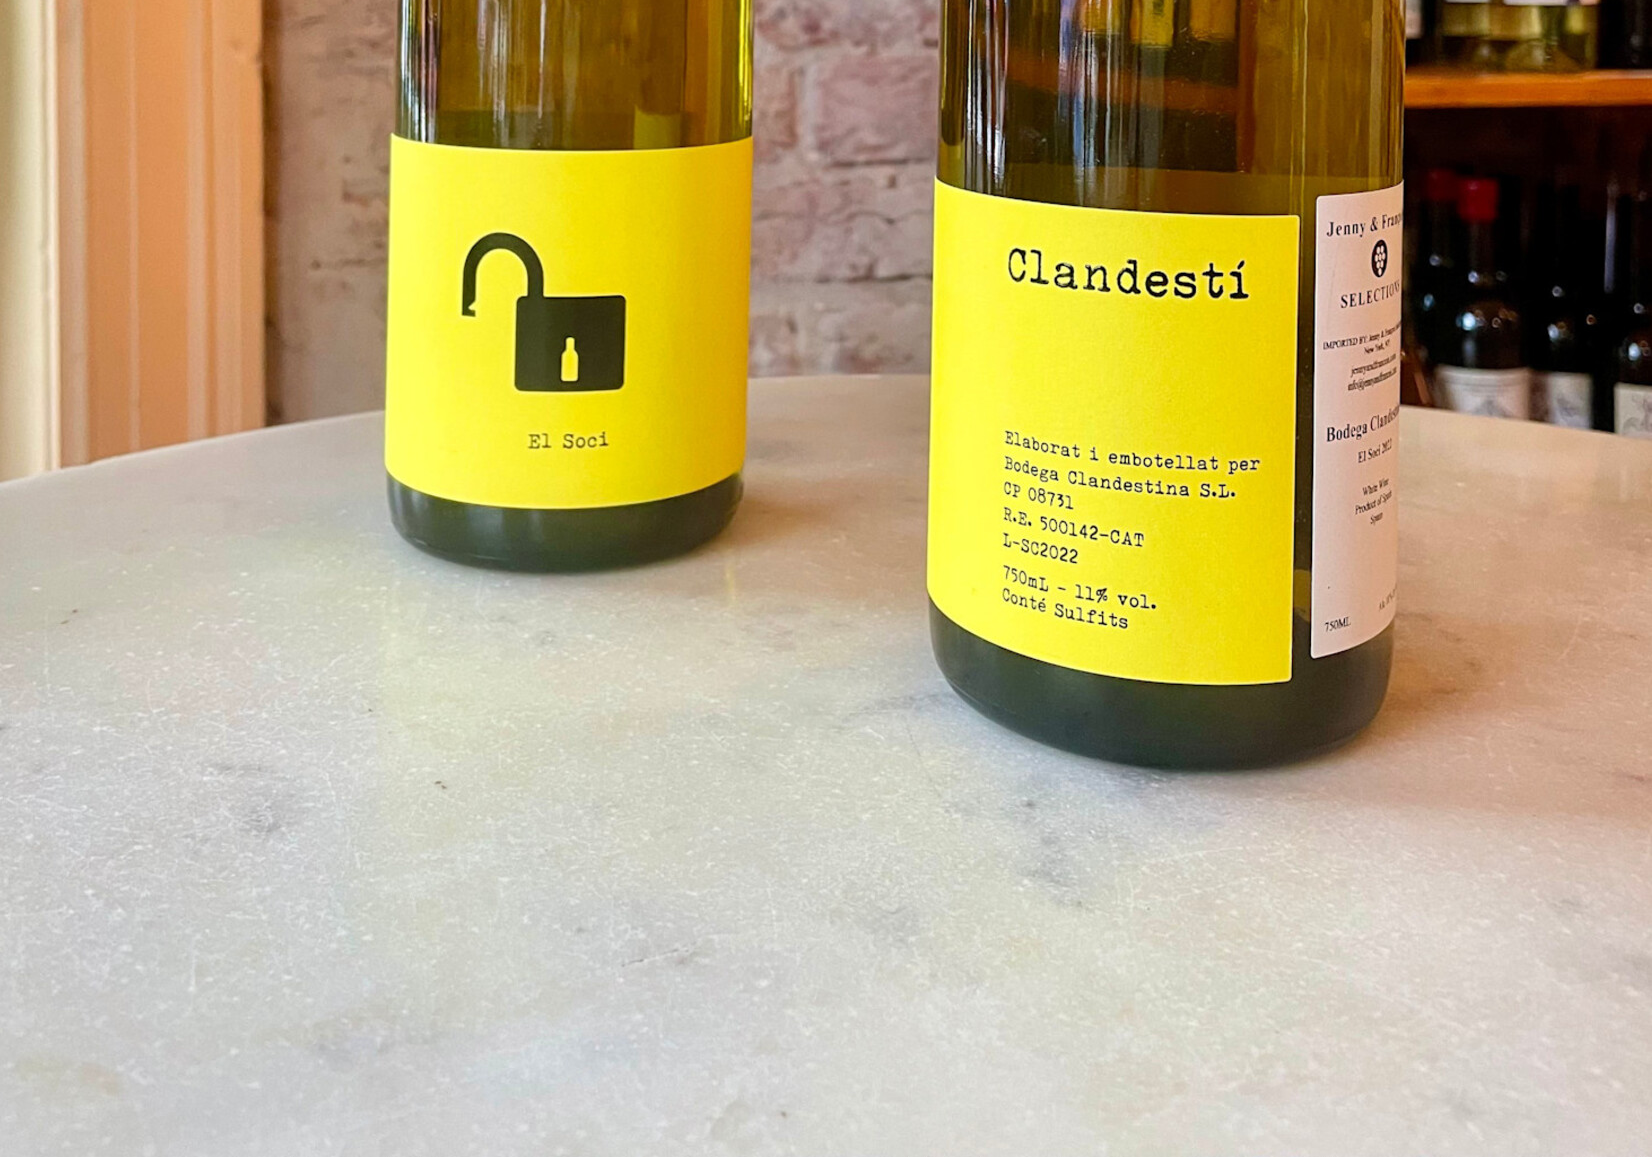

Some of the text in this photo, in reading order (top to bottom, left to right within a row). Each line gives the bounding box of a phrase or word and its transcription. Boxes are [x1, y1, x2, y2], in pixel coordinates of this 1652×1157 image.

[1326, 221, 1366, 238] Jenny
[1370, 216, 1378, 232] &
[1008, 247, 1249, 299] Clandestí
[528, 431, 609, 449] El Soci
[1004, 430, 1261, 475] Elaborat i embotellat per
[1326, 423, 1368, 442] Bodega
[1003, 481, 1075, 510] CP 08731
[1004, 456, 1237, 499] Bodega Clandestina S.L.
[1003, 507, 1145, 547] R.E. 500142-CAT
[1003, 532, 1079, 564] L-SC2022
[1003, 565, 1049, 592] 750mL
[1074, 584, 1108, 604] 11%
[1117, 593, 1157, 610] vol.
[1002, 587, 1129, 629] Conté Sulfits
